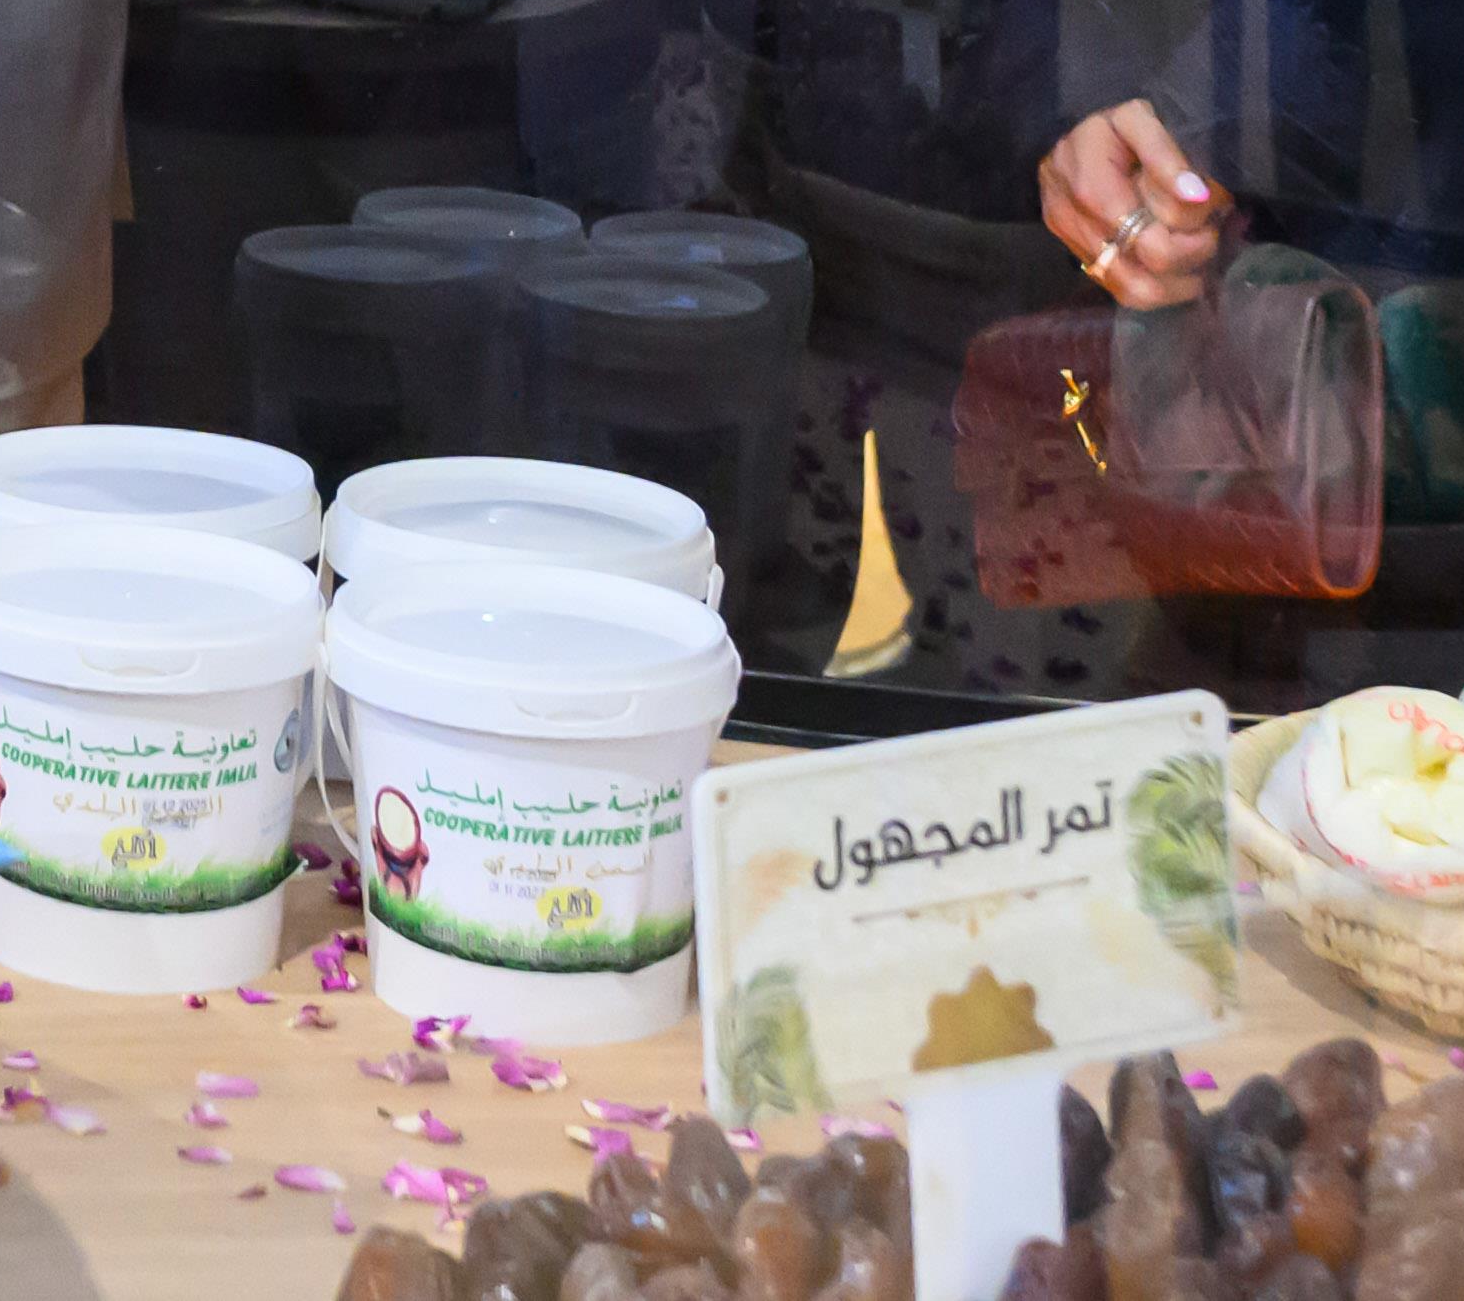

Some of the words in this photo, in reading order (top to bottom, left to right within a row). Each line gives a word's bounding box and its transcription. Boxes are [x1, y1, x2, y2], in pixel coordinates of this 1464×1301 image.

[1, 742, 120, 789] COOPERATIVE
[126, 769, 212, 791] LAITIERE
[79, 733, 165, 763] حليب
[172, 728, 258, 765] تعاونية
[415, 768, 504, 822] إمليل
[512, 790, 601, 822] حليب
[607, 778, 684, 818] تعاونية
[423, 806, 557, 846] COOPERATIVE
[561, 825, 644, 847] LAITIERE
[1037, 778, 1114, 856] تمر
[811, 785, 1026, 891] المجهول
